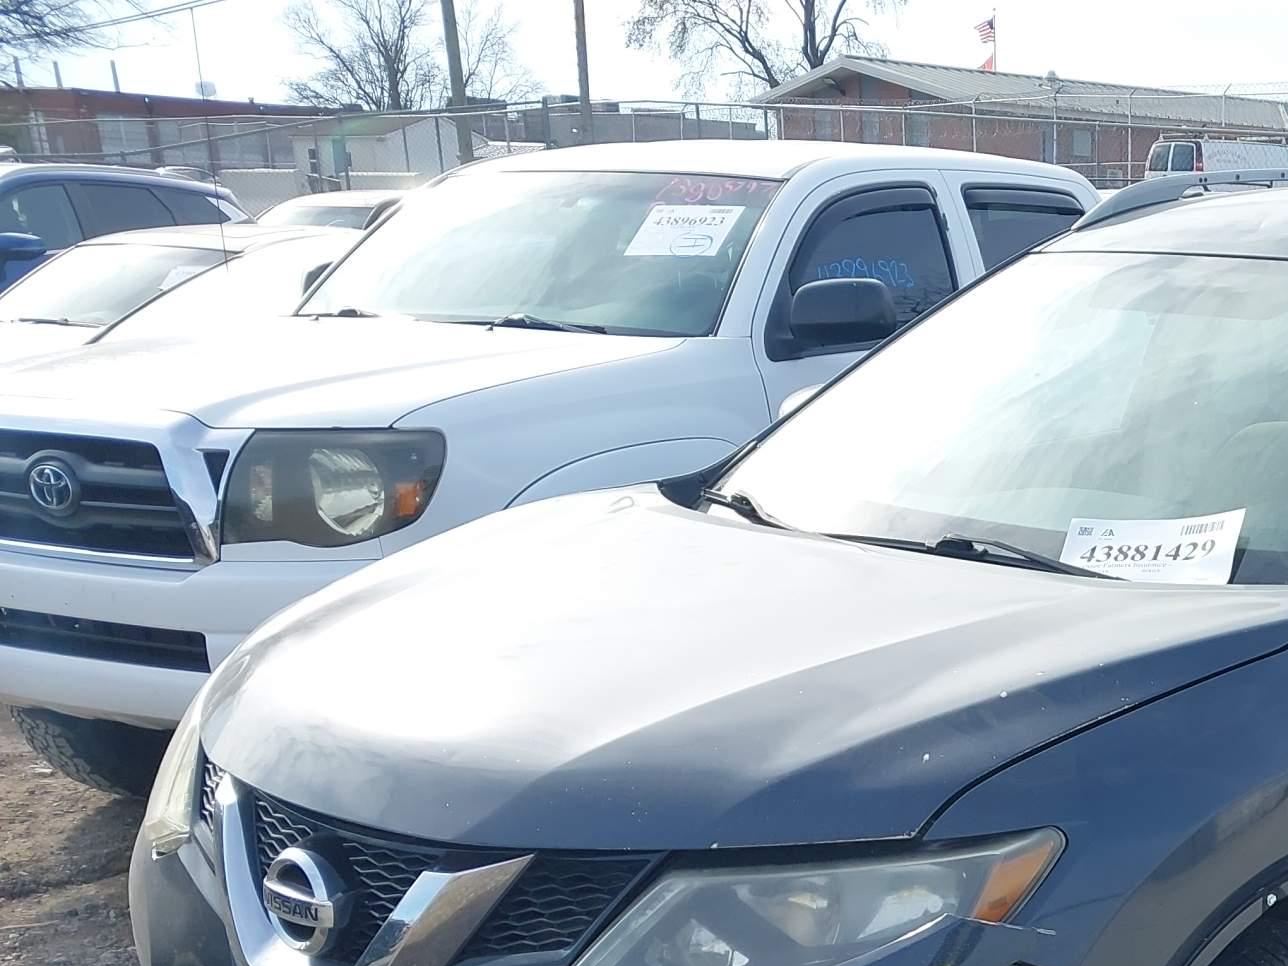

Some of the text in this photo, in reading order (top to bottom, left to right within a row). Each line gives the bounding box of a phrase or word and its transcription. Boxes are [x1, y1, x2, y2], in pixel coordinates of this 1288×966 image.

[653, 216, 726, 226] 43896923
[1079, 539, 1216, 563] 43881429
[266, 893, 319, 922] NISSAN
